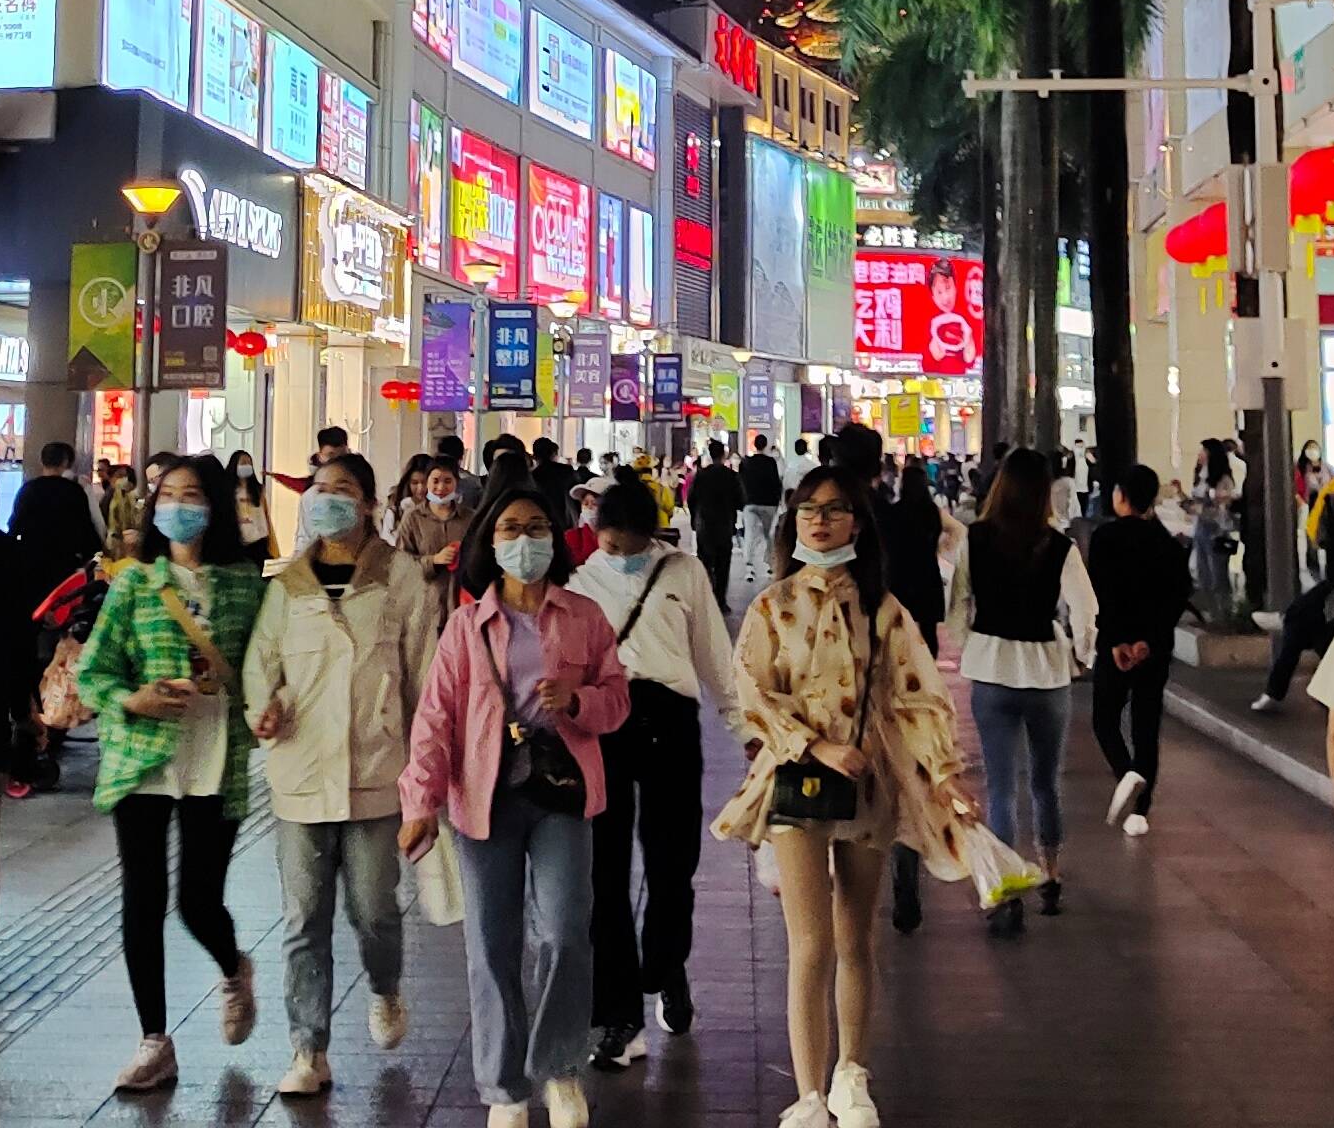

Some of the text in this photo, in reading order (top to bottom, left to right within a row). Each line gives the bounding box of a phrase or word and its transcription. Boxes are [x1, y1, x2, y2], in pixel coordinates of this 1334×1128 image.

[171, 275, 215, 298] 非凡
[171, 304, 215, 328] 口腔
[496, 327, 529, 345] 非凡
